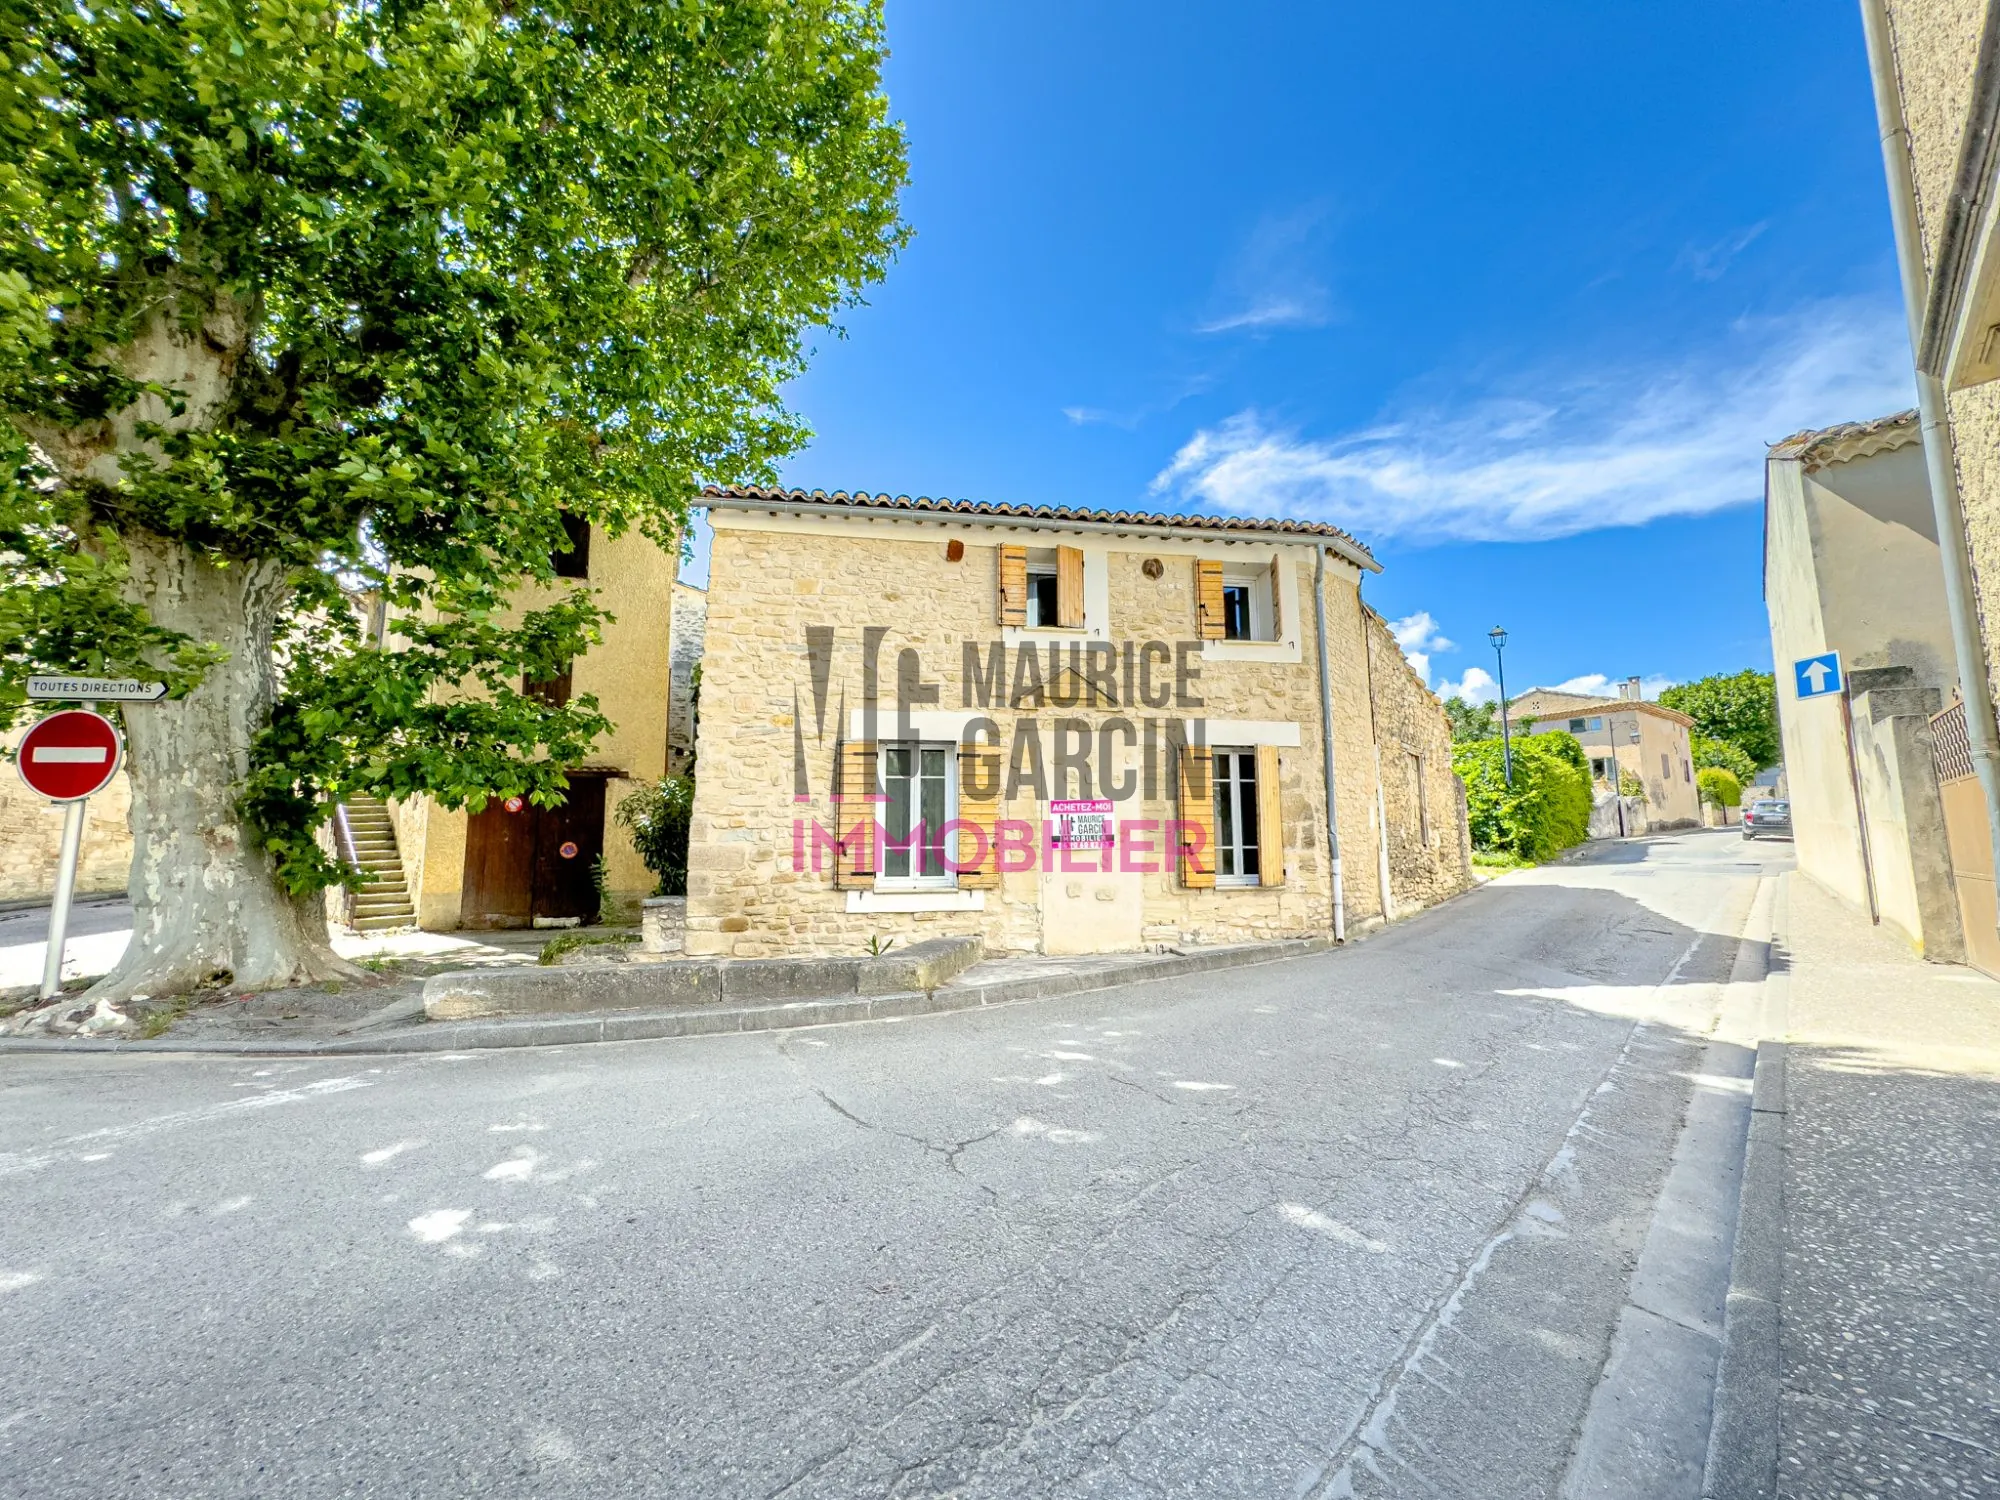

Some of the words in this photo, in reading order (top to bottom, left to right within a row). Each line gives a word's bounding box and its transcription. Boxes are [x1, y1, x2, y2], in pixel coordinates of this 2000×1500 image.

[33, 682, 78, 692] TOUTES
[81, 683, 152, 693] DIRECTIONS
[1052, 803, 1112, 812] ACHETEZ-MOI
[1077, 815, 1105, 823] MAURICE
[1078, 824, 1106, 834] GARCIN
